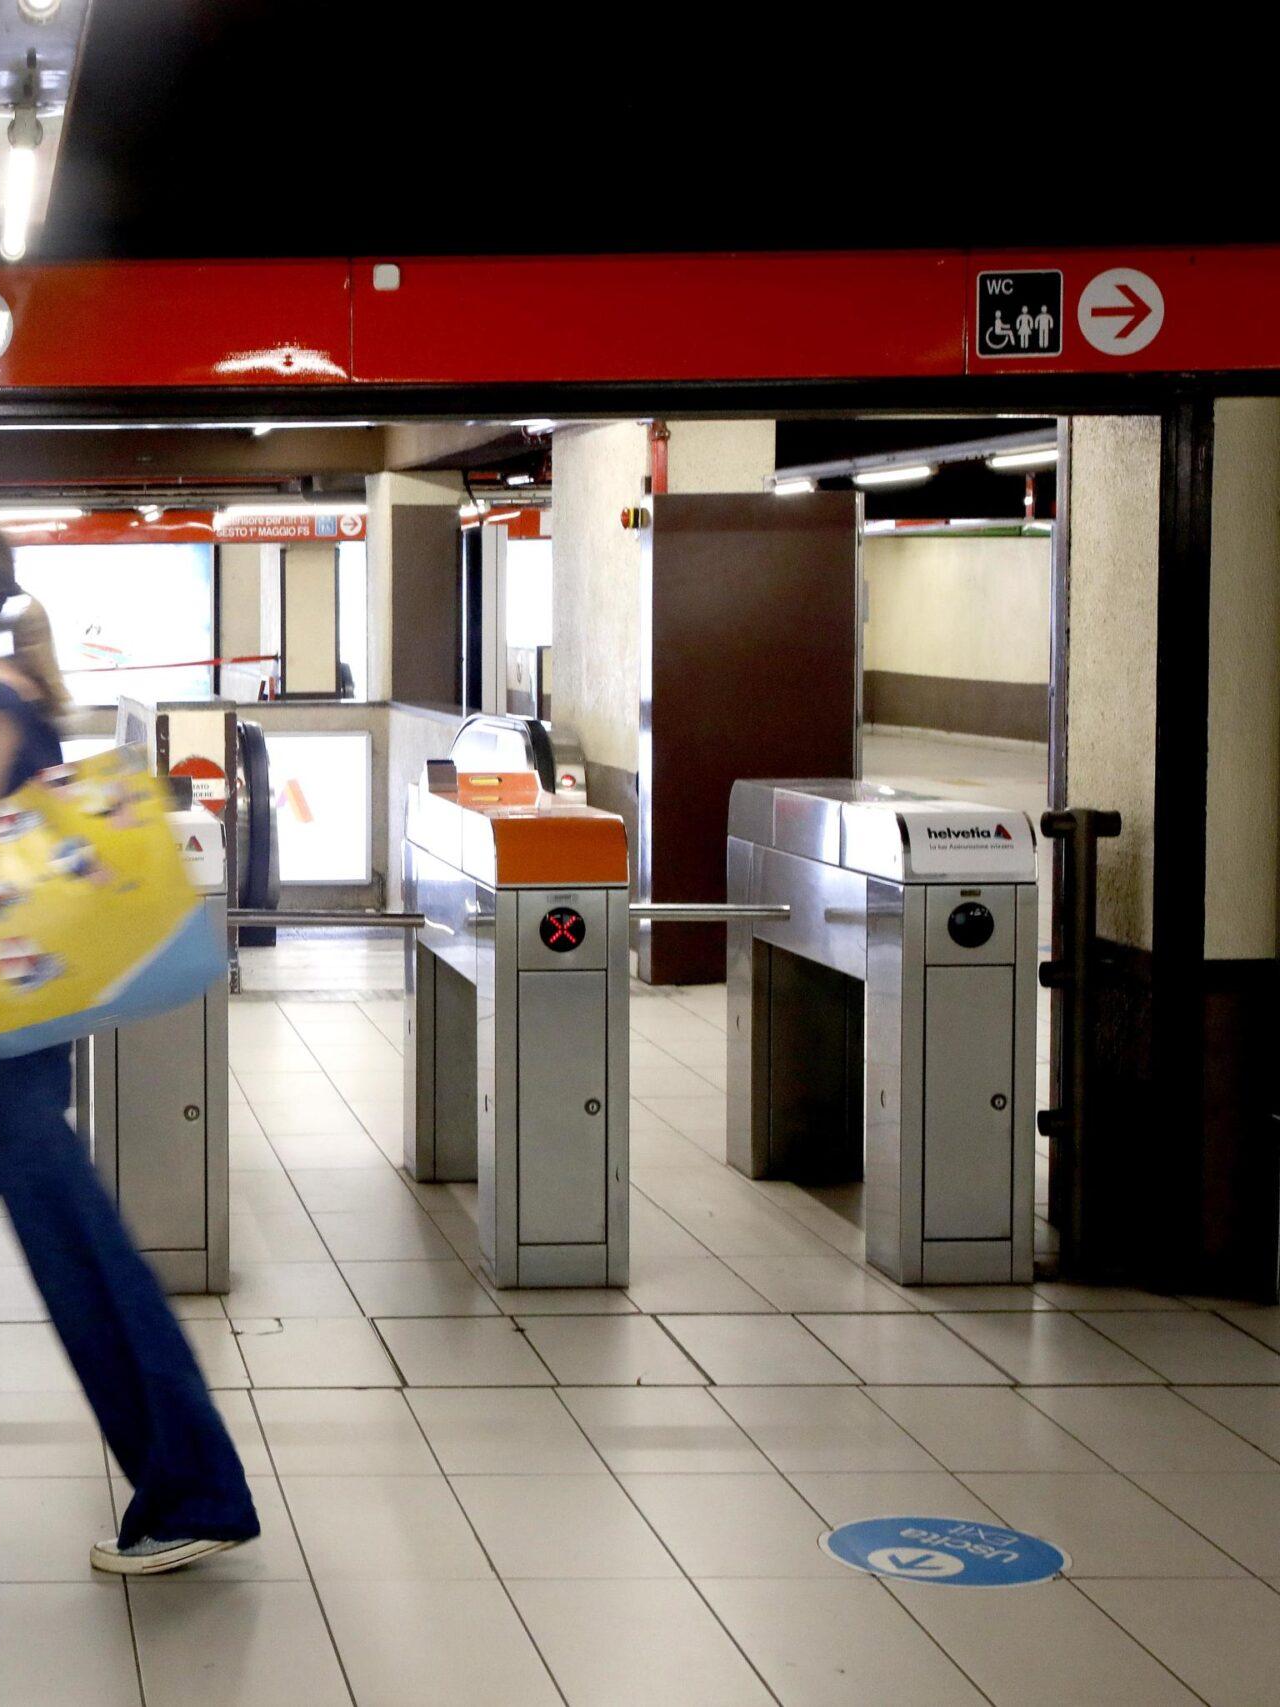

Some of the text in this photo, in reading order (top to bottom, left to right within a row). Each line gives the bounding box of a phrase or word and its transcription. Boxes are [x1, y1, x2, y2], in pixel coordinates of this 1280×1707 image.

[986, 279, 1014, 295] WC
[217, 526, 247, 537] SESTO
[258, 526, 295, 536] MAGGIO
[297, 526, 310, 536] FS
[927, 827, 991, 839] helvetia
[899, 1527, 1019, 1564] Uscita
